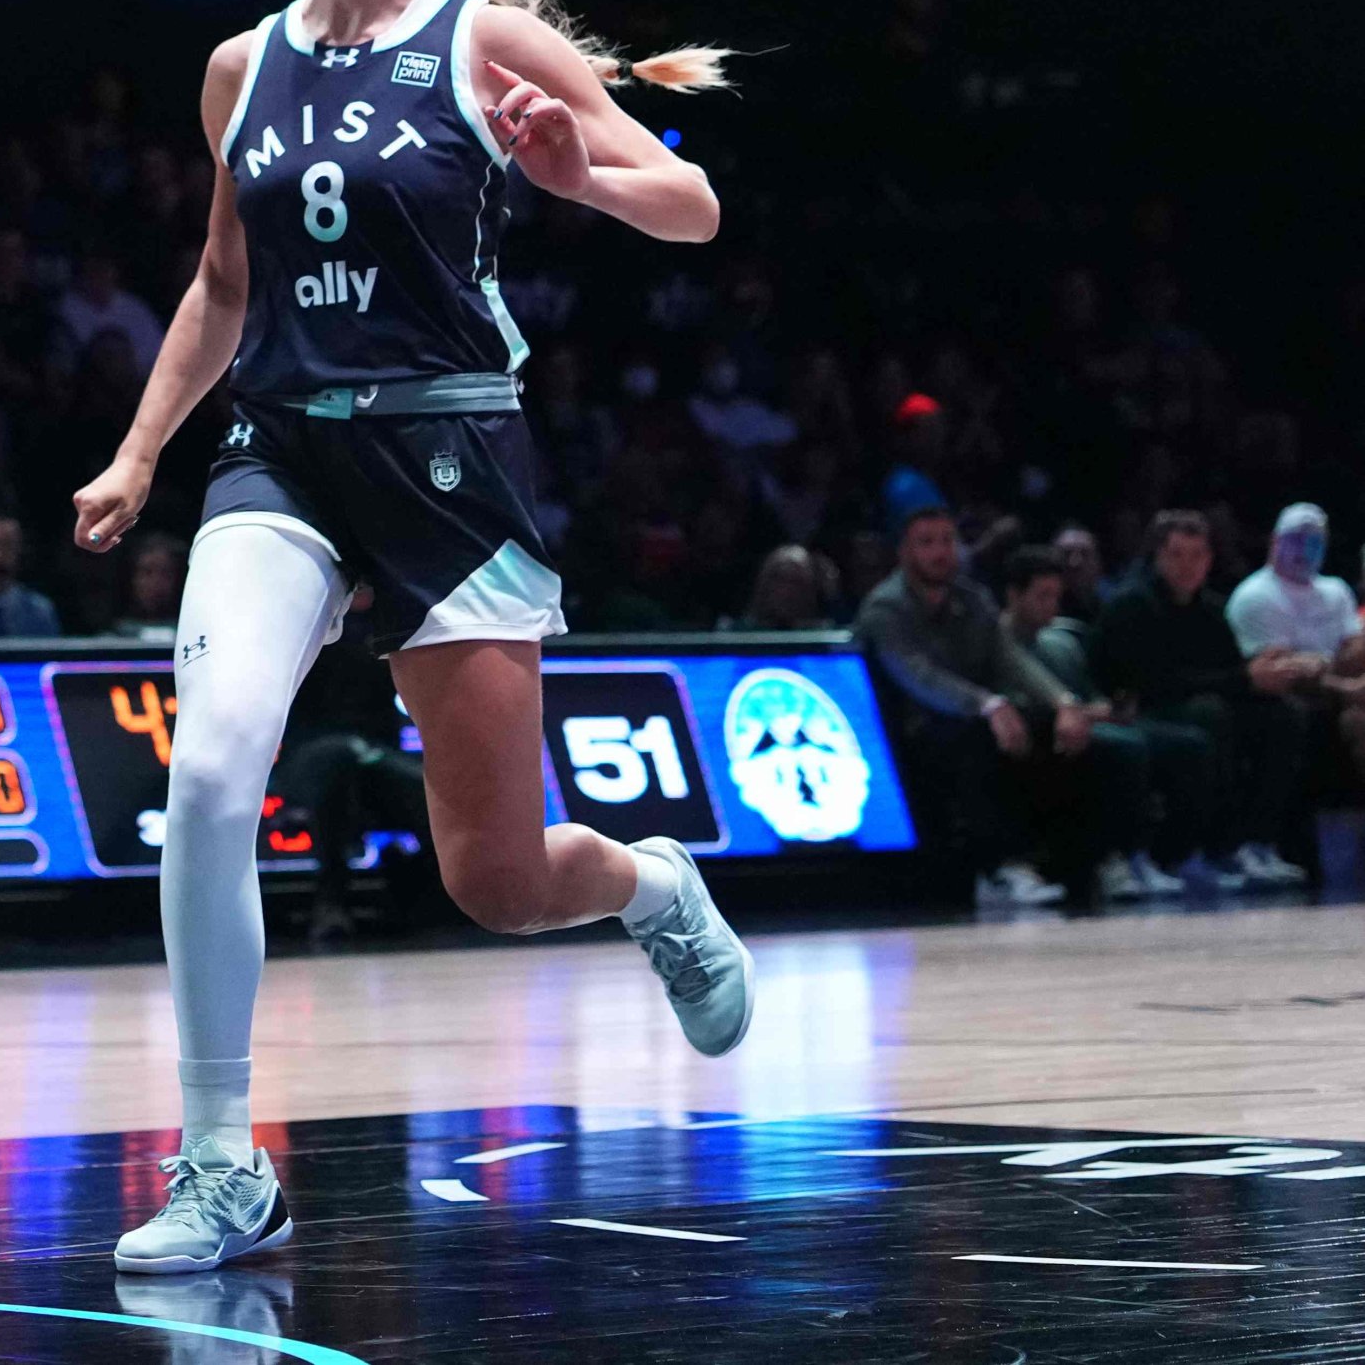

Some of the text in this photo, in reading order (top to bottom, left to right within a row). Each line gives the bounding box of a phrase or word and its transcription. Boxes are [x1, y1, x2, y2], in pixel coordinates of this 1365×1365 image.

[245, 101, 428, 178] MIST
[300, 161, 348, 243] 8
[295, 261, 379, 313] ally
[562, 715, 691, 803] 51
